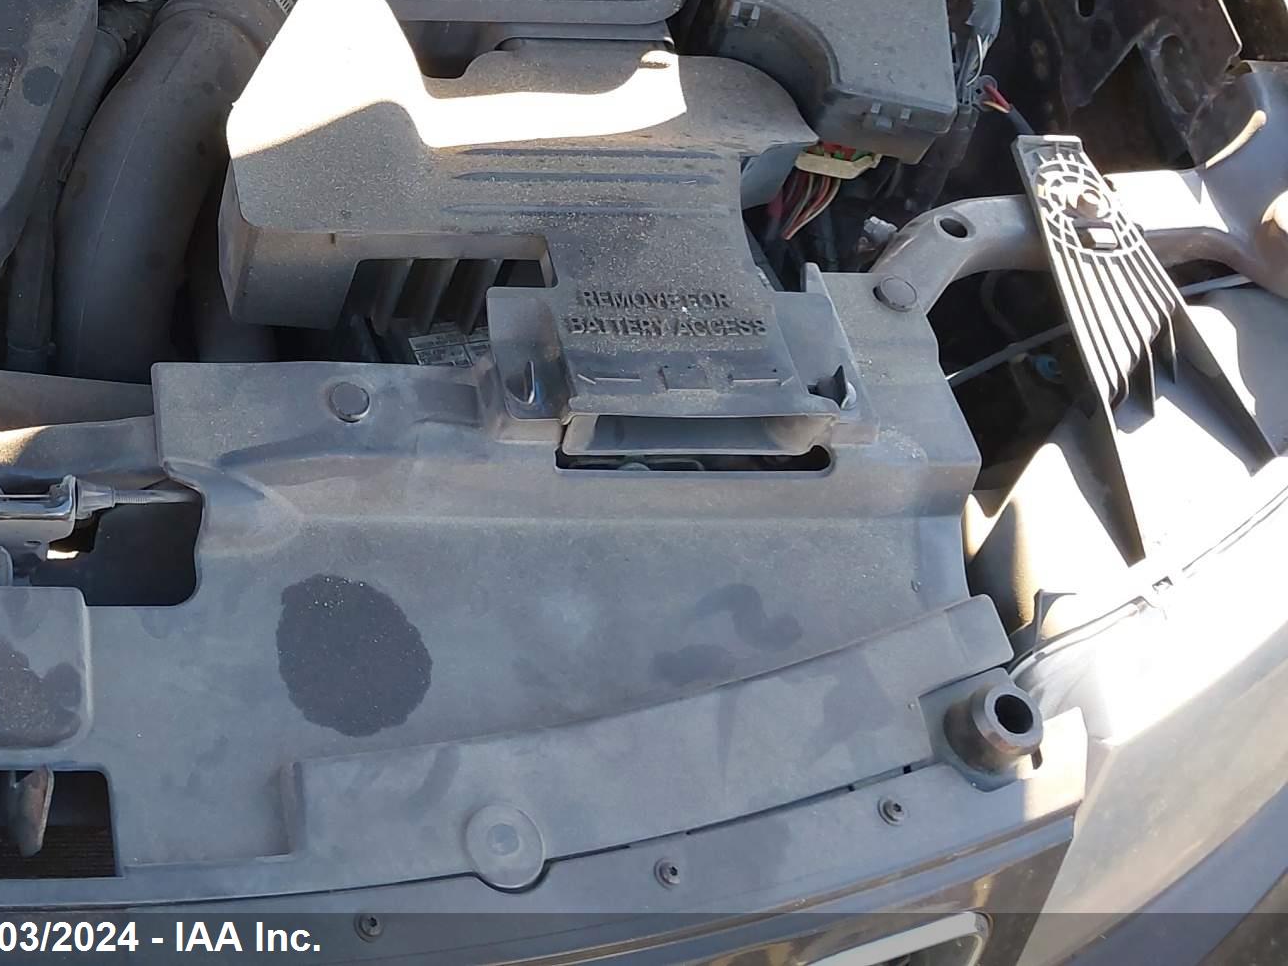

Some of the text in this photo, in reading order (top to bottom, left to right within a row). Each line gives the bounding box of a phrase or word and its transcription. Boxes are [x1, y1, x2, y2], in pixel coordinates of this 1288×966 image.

[581, 290, 732, 309] REMOVE FOR
[568, 315, 767, 336] BATTERY ACCESS
